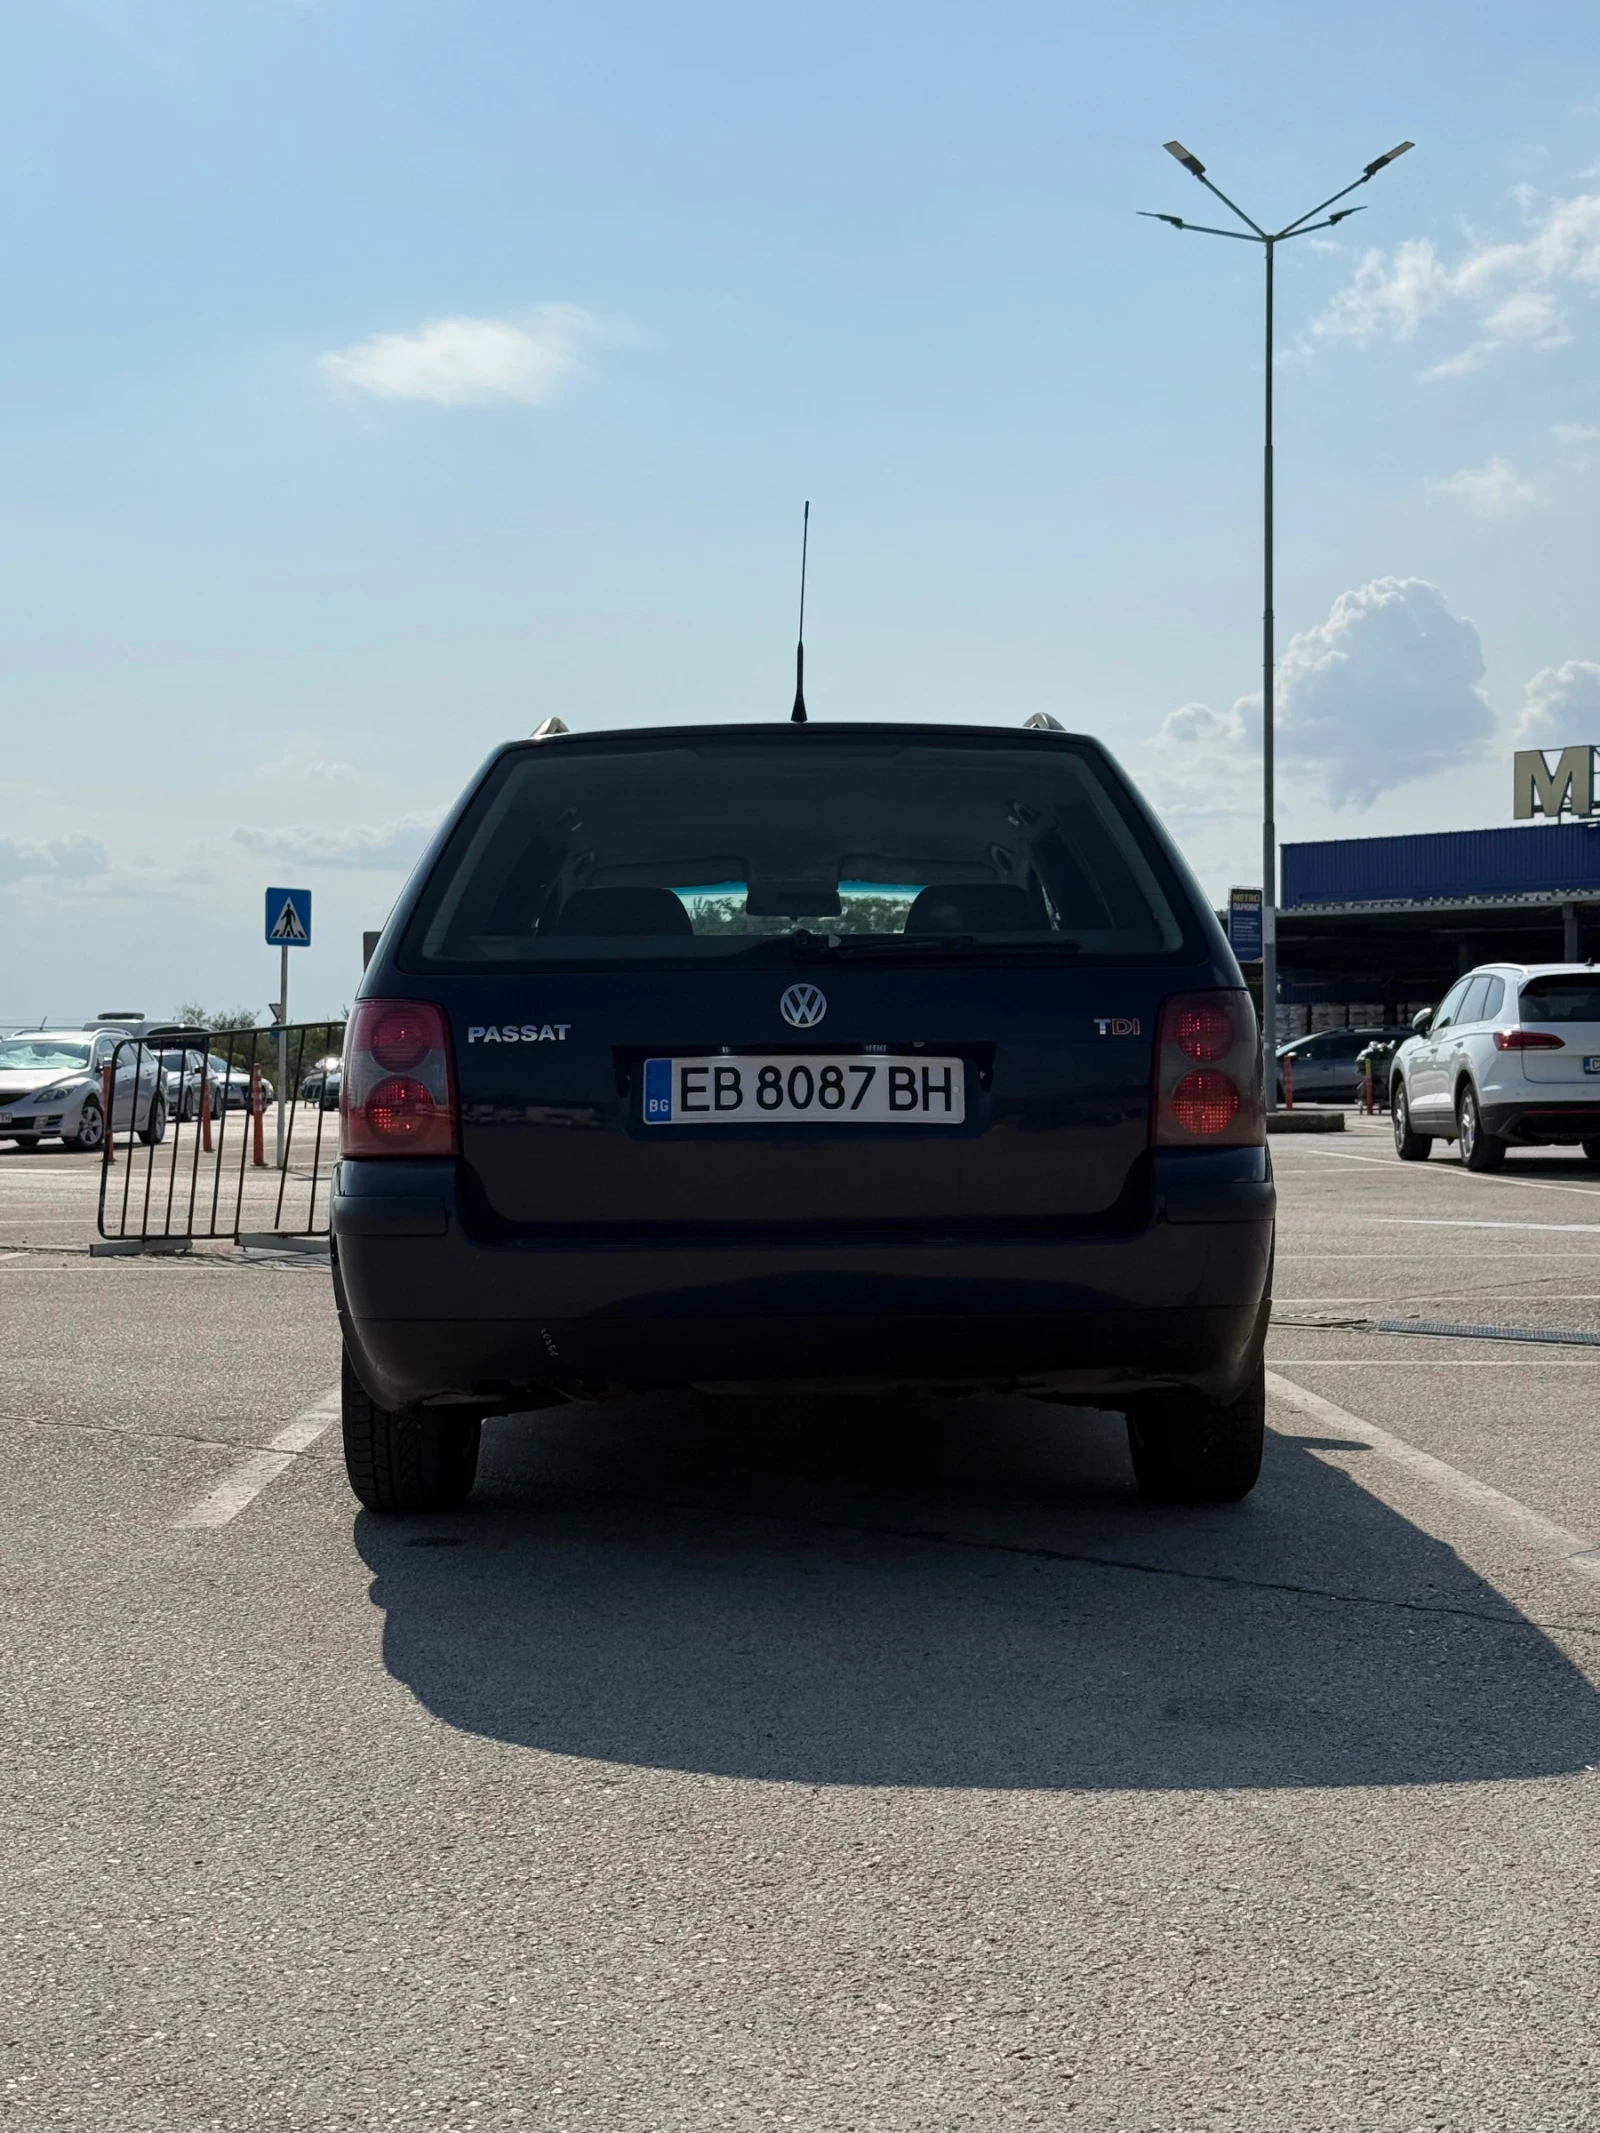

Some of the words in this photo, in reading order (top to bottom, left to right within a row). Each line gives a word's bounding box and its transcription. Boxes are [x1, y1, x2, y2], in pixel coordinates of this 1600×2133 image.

[1232, 894, 1260, 903] METRO
[779, 983, 827, 1028] VW
[468, 1024, 571, 1043] PASSAT
[1093, 1018, 1140, 1035] TDI
[681, 1066, 743, 1112] EB
[756, 1065, 876, 1111] 8087
[888, 1066, 951, 1112] BH
[649, 1099, 669, 1112] BG
